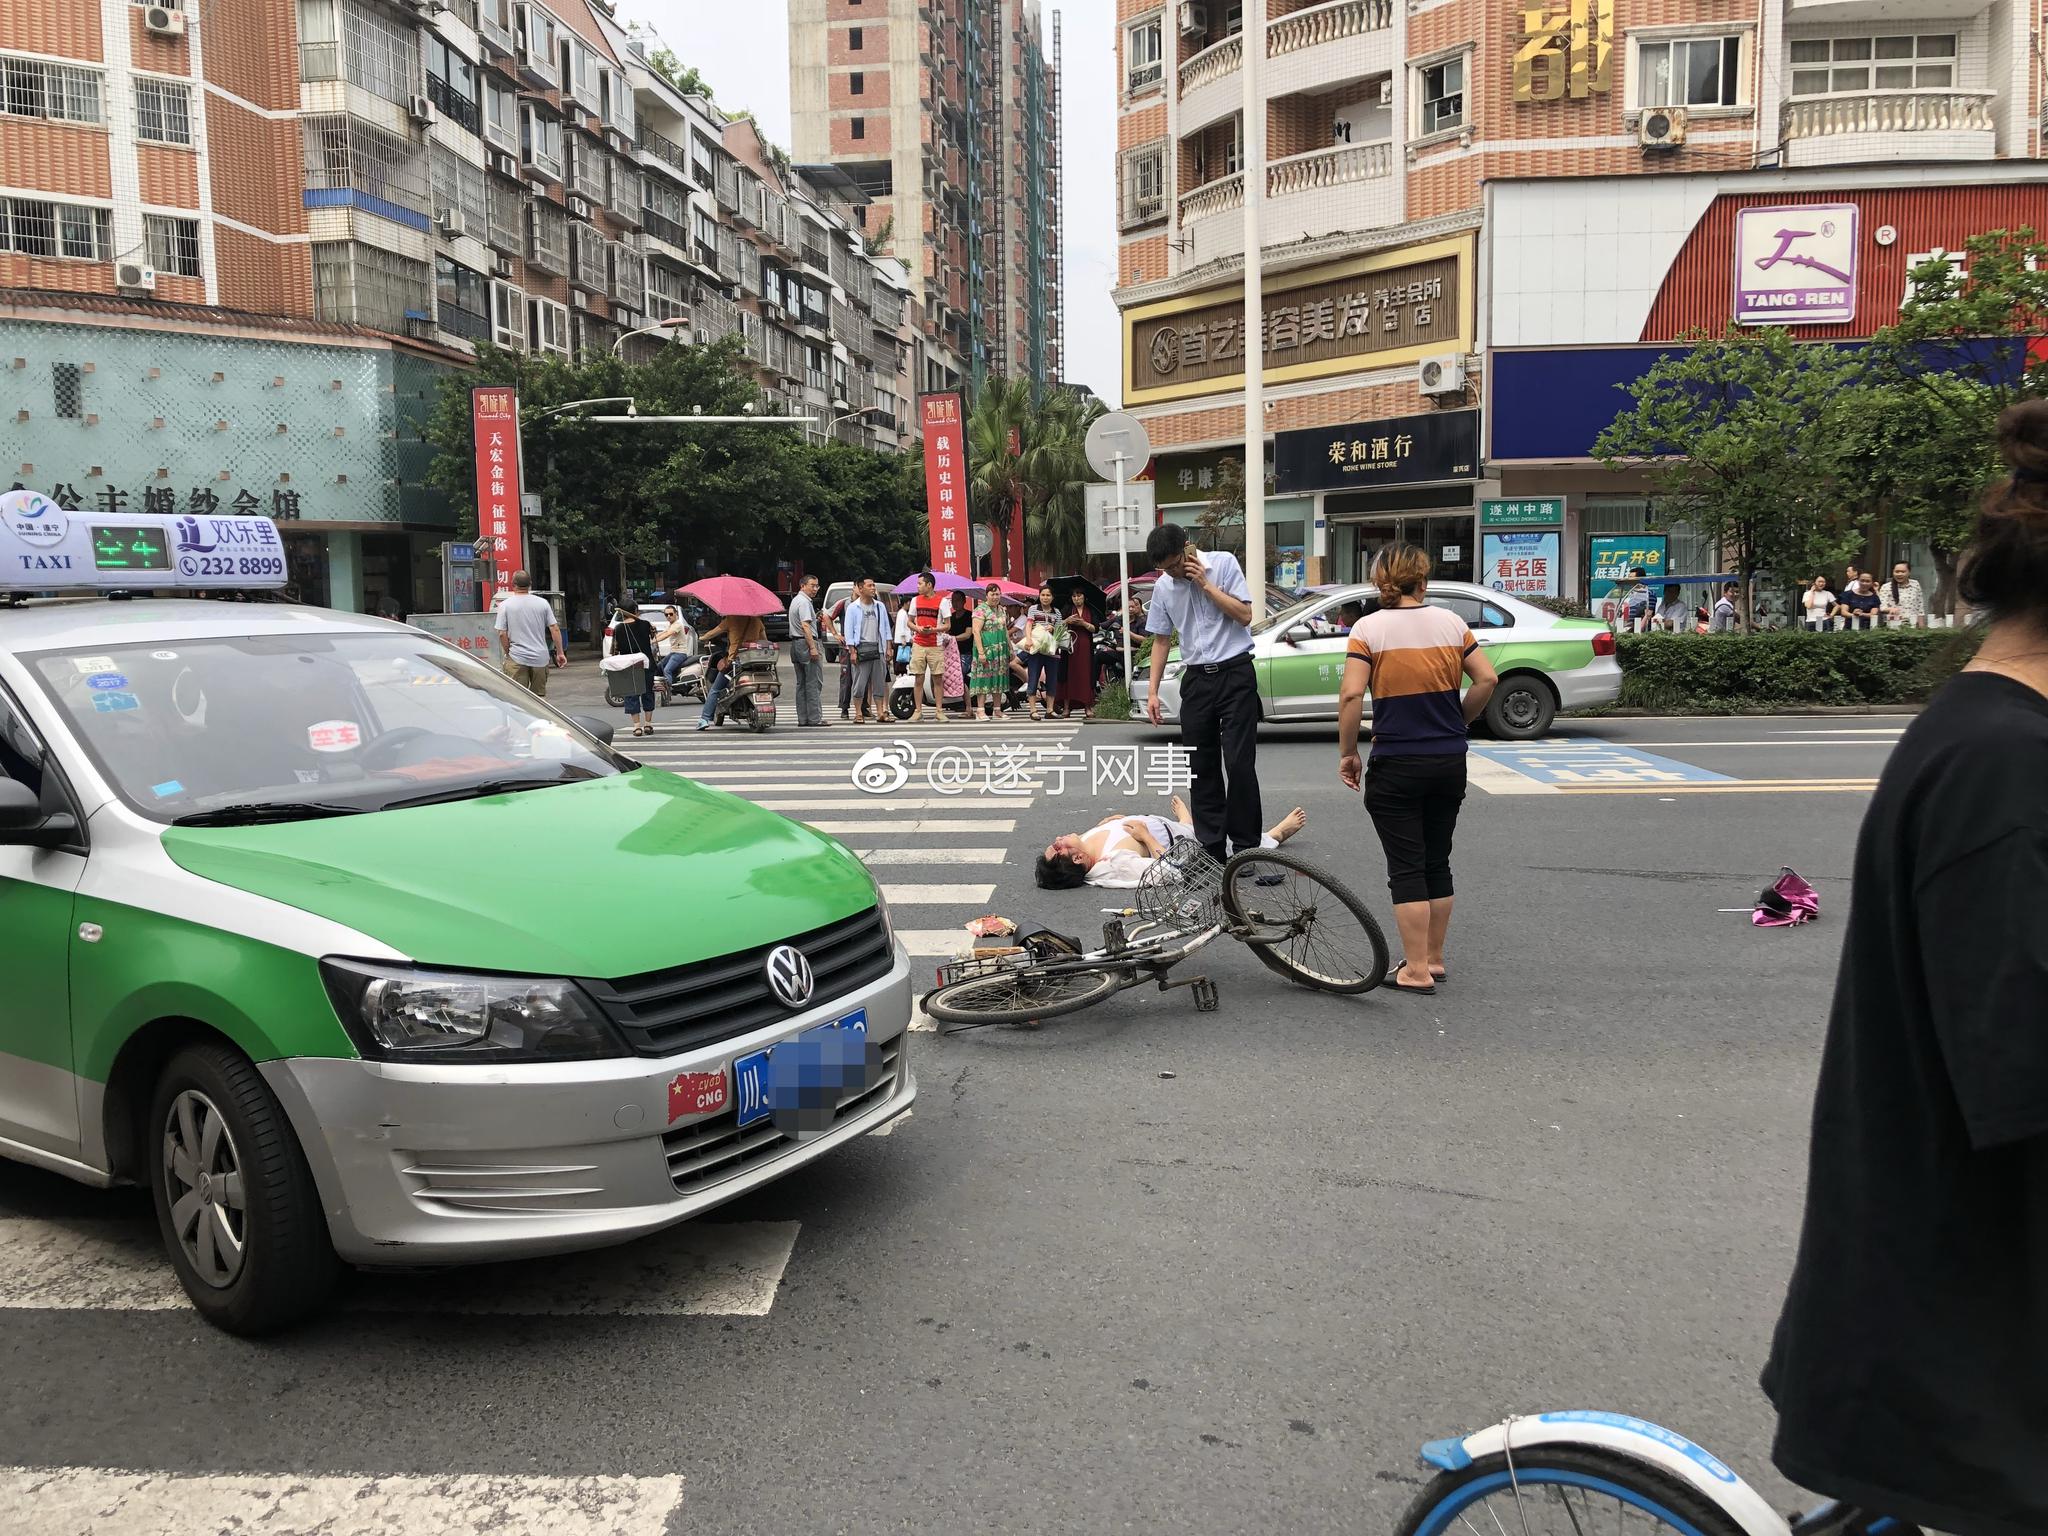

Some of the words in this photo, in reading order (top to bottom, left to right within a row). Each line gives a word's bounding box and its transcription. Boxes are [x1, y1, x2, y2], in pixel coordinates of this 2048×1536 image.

[1374, 277, 1442, 310] 养生会所
[1328, 434, 1413, 465] 荣和酒行
[489, 431, 505, 496] 天宏金街
[1359, 462, 1376, 471] WINE
[1376, 460, 1398, 469] STORE
[936, 435, 954, 520] 载历史印迹
[10, 482, 301, 520] 公主婚纱会馆
[1489, 503, 1553, 516] 遂州中路
[209, 520, 277, 545] 欢乐里
[942, 527, 958, 574] 拓品味
[1596, 551, 1629, 565] 工厂
[1630, 549, 1661, 565] 开仓
[19, 555, 71, 569] TAXI
[200, 557, 235, 575] 232
[239, 557, 283, 575] 8899
[1497, 558, 1547, 578] 看名医
[1594, 561, 1642, 579] 低至1
[696, 1088, 723, 1108] CNG
